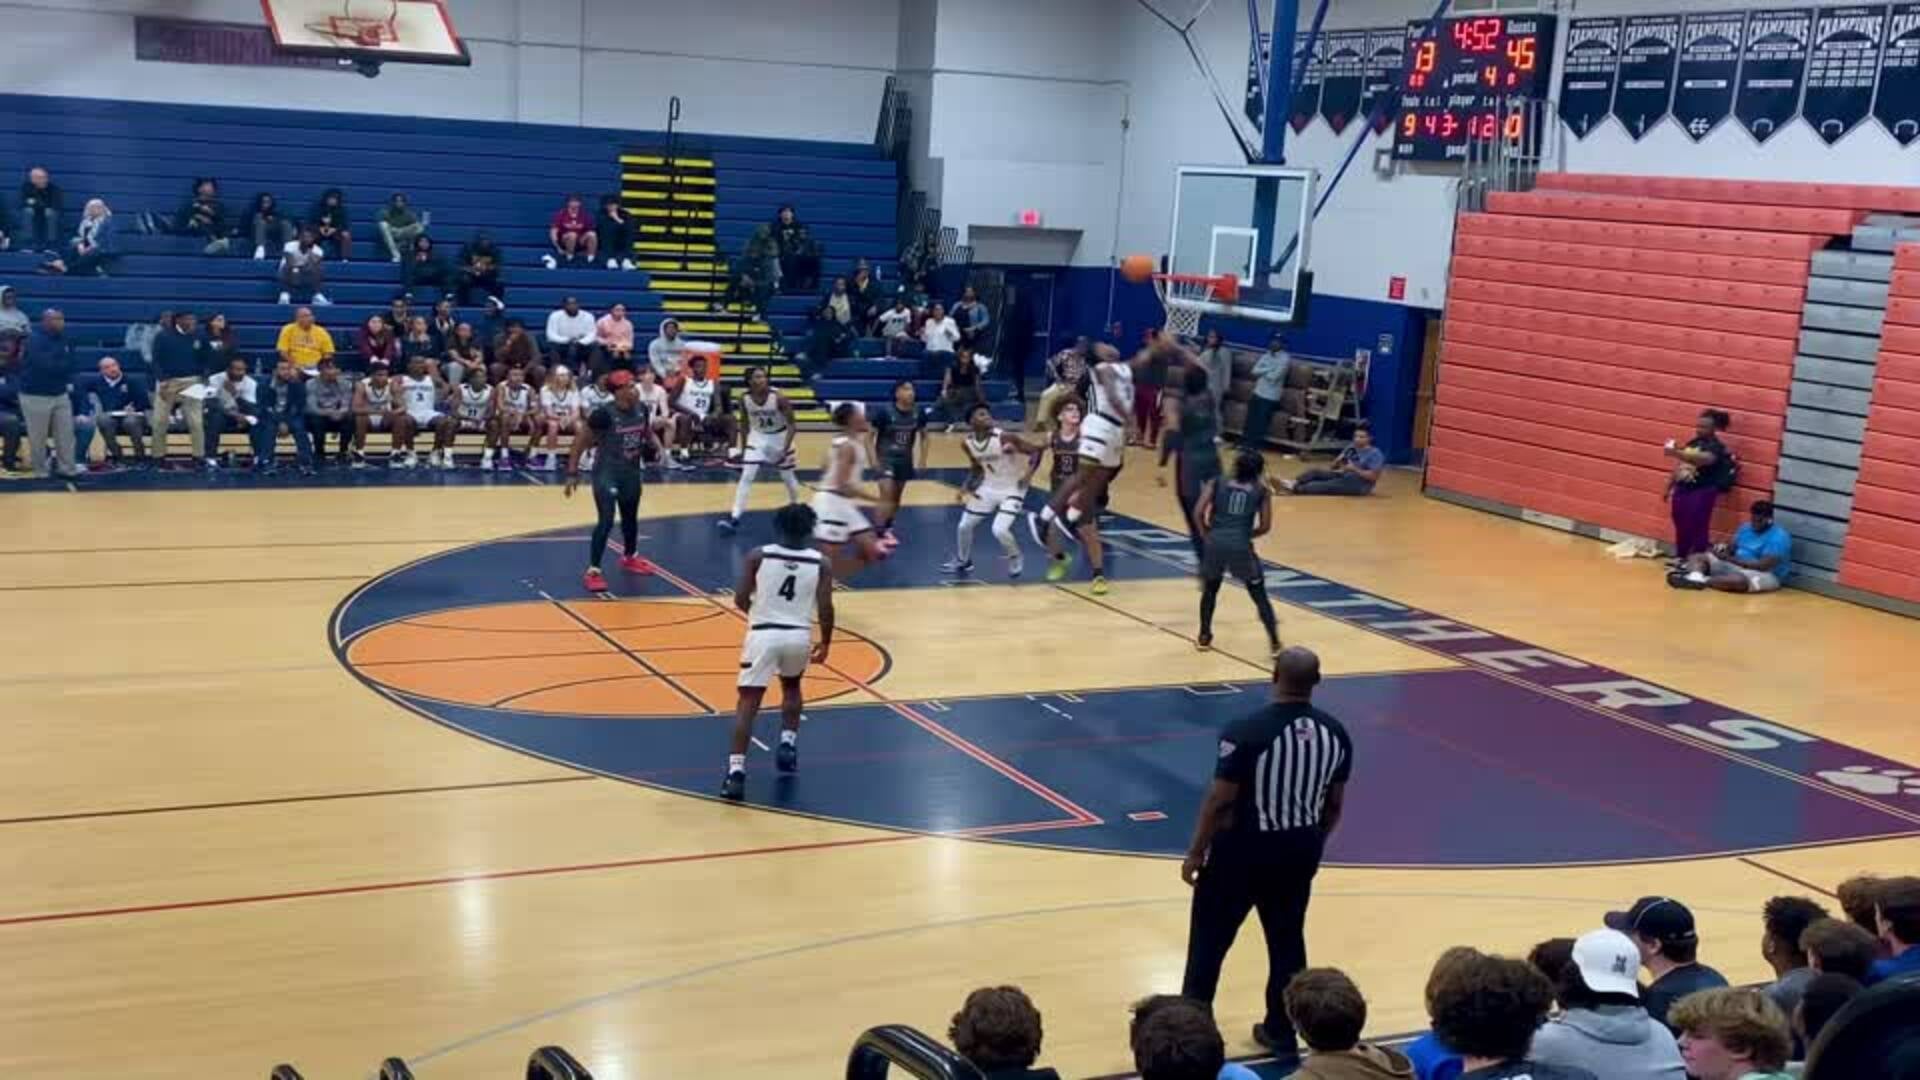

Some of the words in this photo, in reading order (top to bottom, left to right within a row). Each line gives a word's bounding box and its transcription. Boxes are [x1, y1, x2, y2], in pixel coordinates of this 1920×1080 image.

[1454, 19, 1501, 51] 4:52
[1568, 27, 1619, 52] CHAMPIONS
[1624, 24, 1679, 50] CHAMPIONS
[1683, 22, 1742, 48] CHAMPIONS
[1747, 19, 1809, 46] CHAMPIONS
[1815, 15, 1882, 45] CHAMPIONS
[1507, 38, 1536, 69] 45
[1484, 66, 1497, 87] 4
[1404, 113, 1417, 137] 9
[1425, 115, 1437, 135] 4
[778, 574, 797, 602] 4
